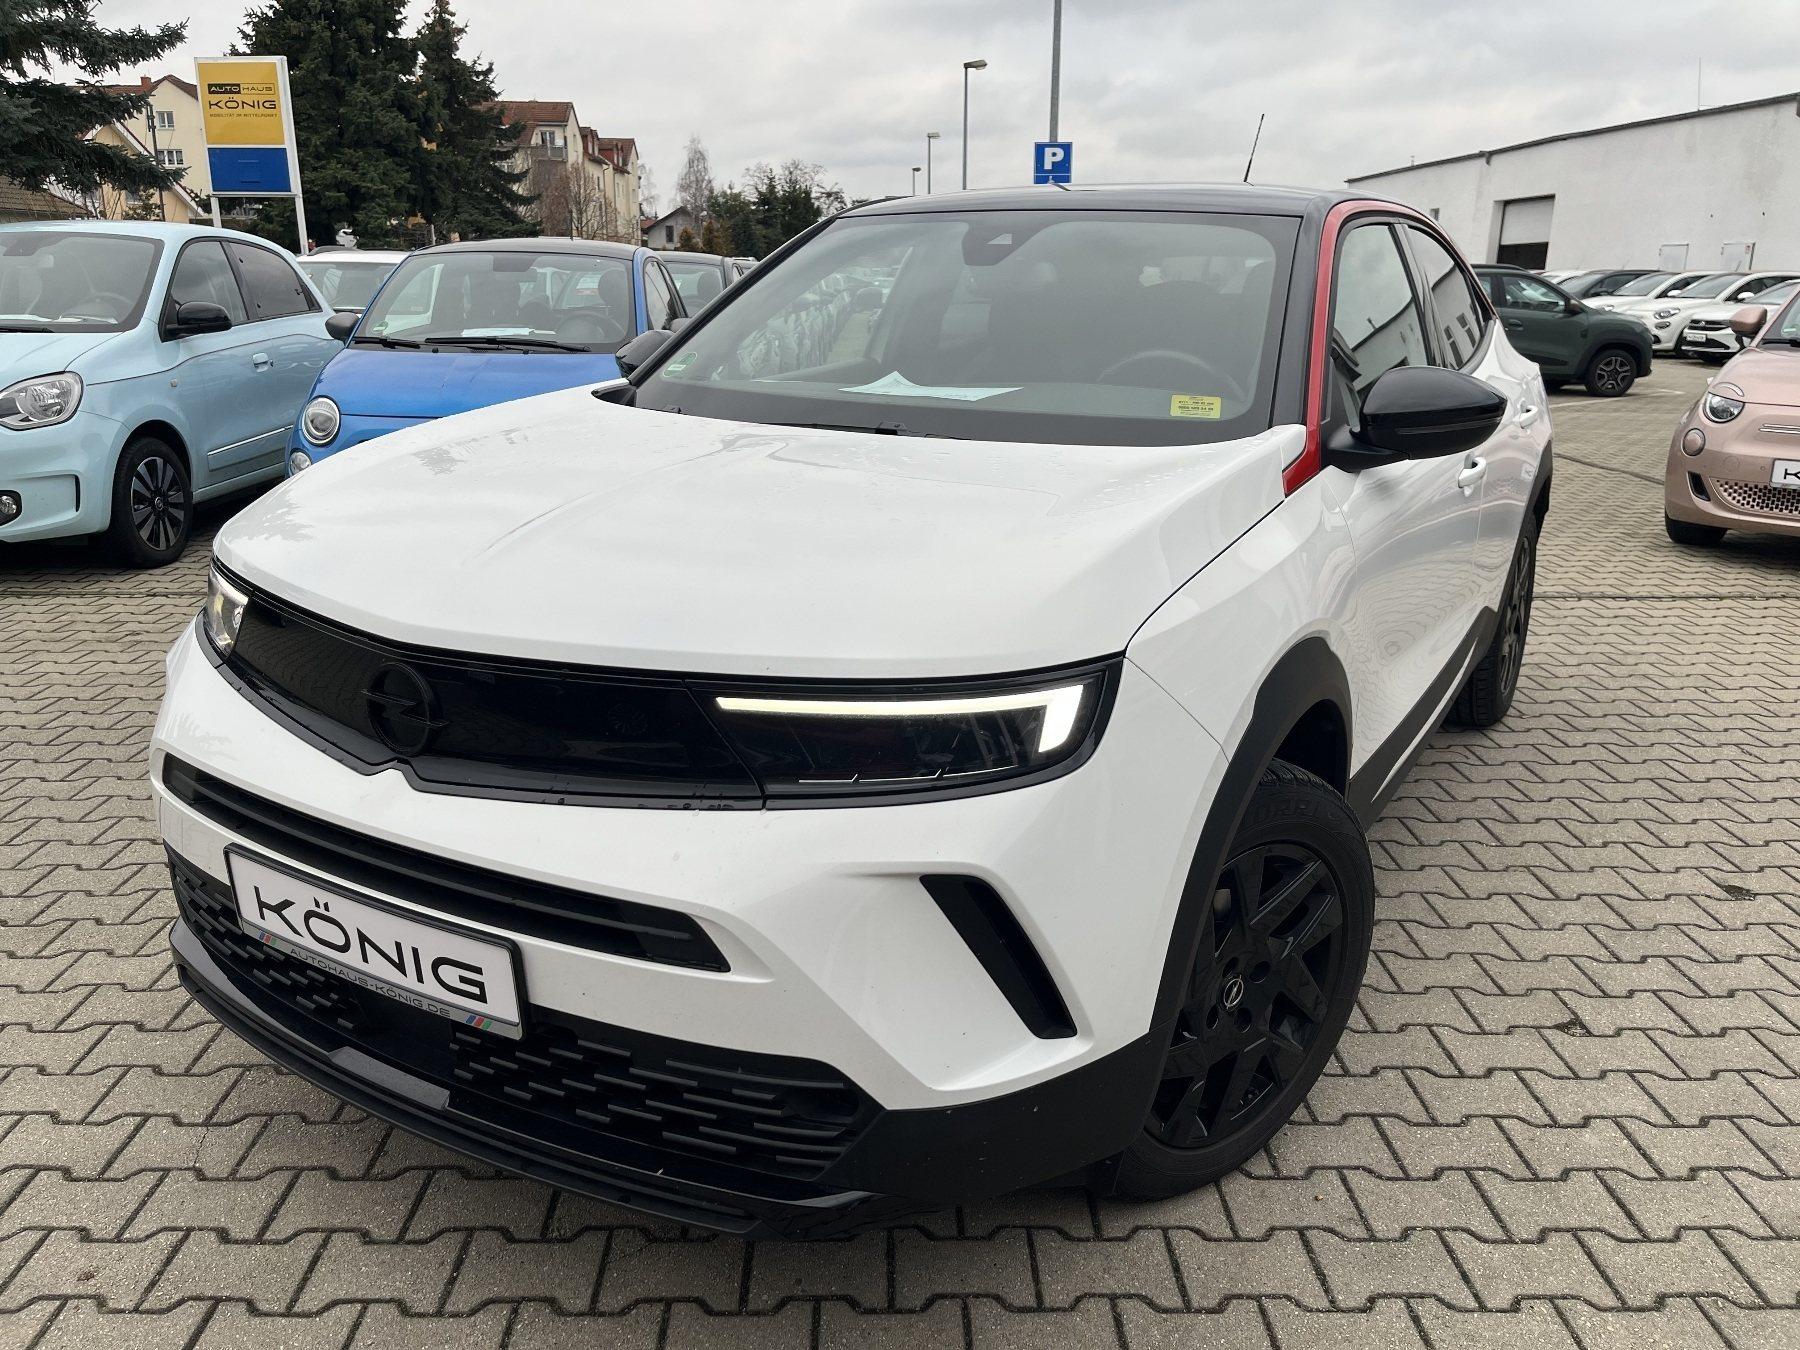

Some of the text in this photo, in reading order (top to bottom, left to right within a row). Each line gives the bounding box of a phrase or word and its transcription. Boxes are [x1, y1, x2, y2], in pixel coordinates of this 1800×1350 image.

[208, 97, 277, 109] KÖNIG
[1043, 147, 1065, 170] P
[253, 885, 488, 1005] KÖNIG
[290, 947, 451, 1018] AUTOHAUS-KÖNIG.DE
